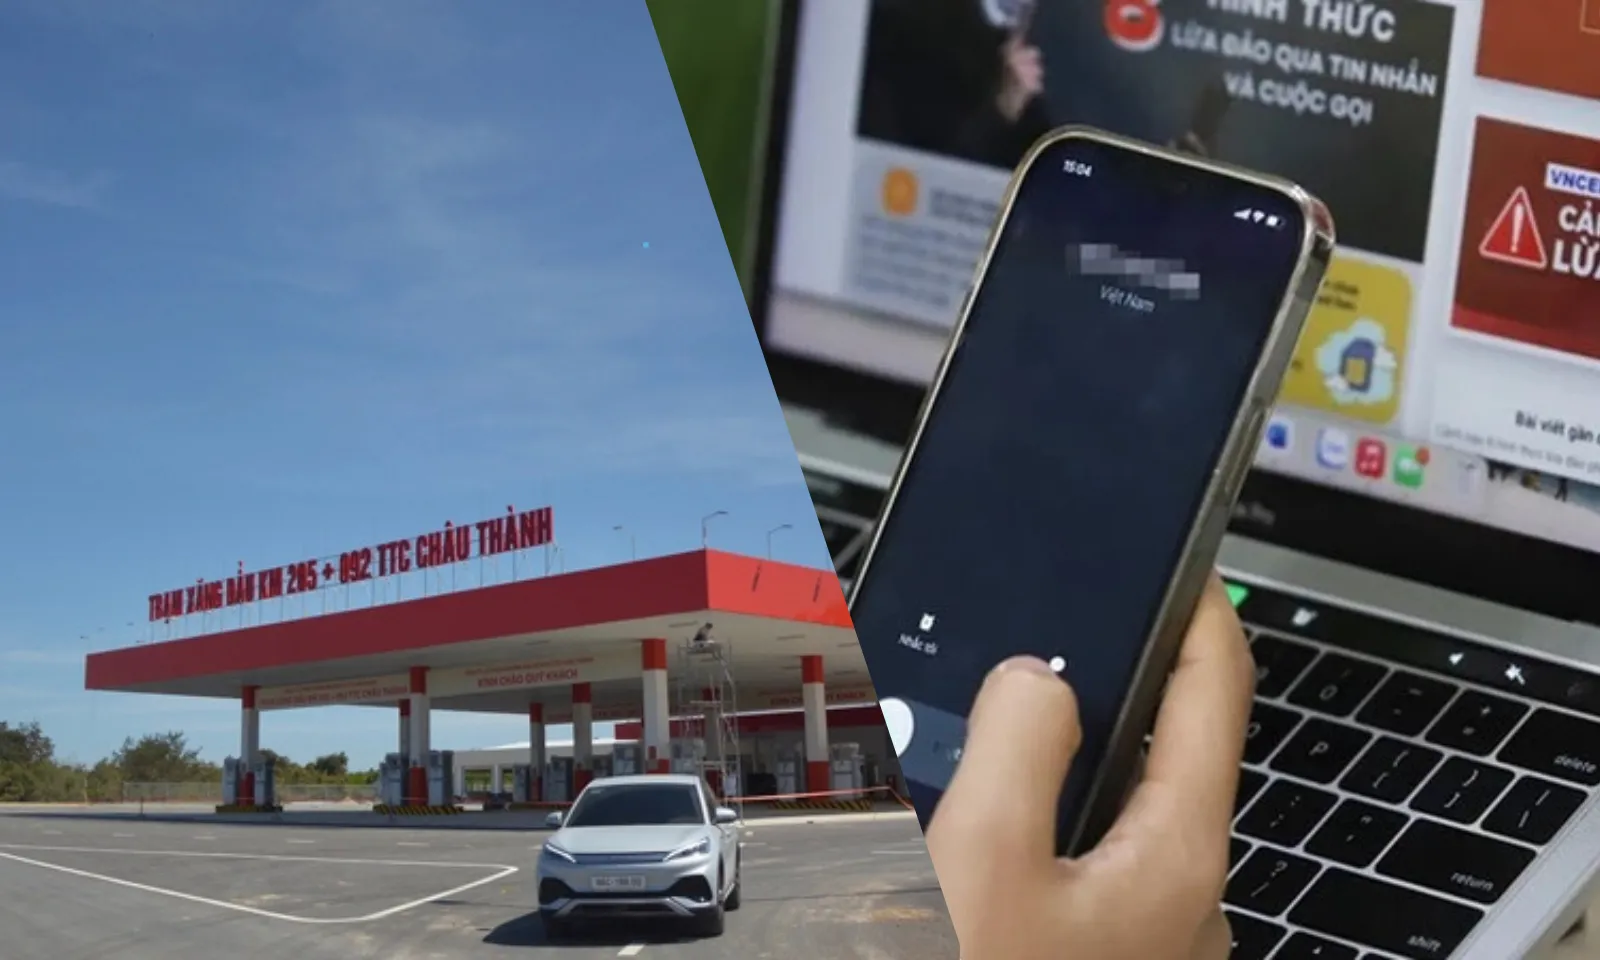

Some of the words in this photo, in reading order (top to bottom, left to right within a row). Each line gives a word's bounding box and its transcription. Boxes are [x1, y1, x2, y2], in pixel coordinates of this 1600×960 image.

[1275, 42, 1325, 74] QUA
[1328, 53, 1367, 83] TIN
[1258, 79, 1327, 115] CUỘC
[1558, 200, 1600, 237] CẢ
[1552, 235, 1600, 280] LỪ
[259, 567, 283, 600] KM
[376, 539, 411, 577] TTC
[415, 520, 471, 568] CHÂU
[475, 505, 553, 556] THÀNH
[1554, 754, 1597, 774] delete
[1450, 871, 1494, 892] return
[1408, 934, 1441, 952] shift
